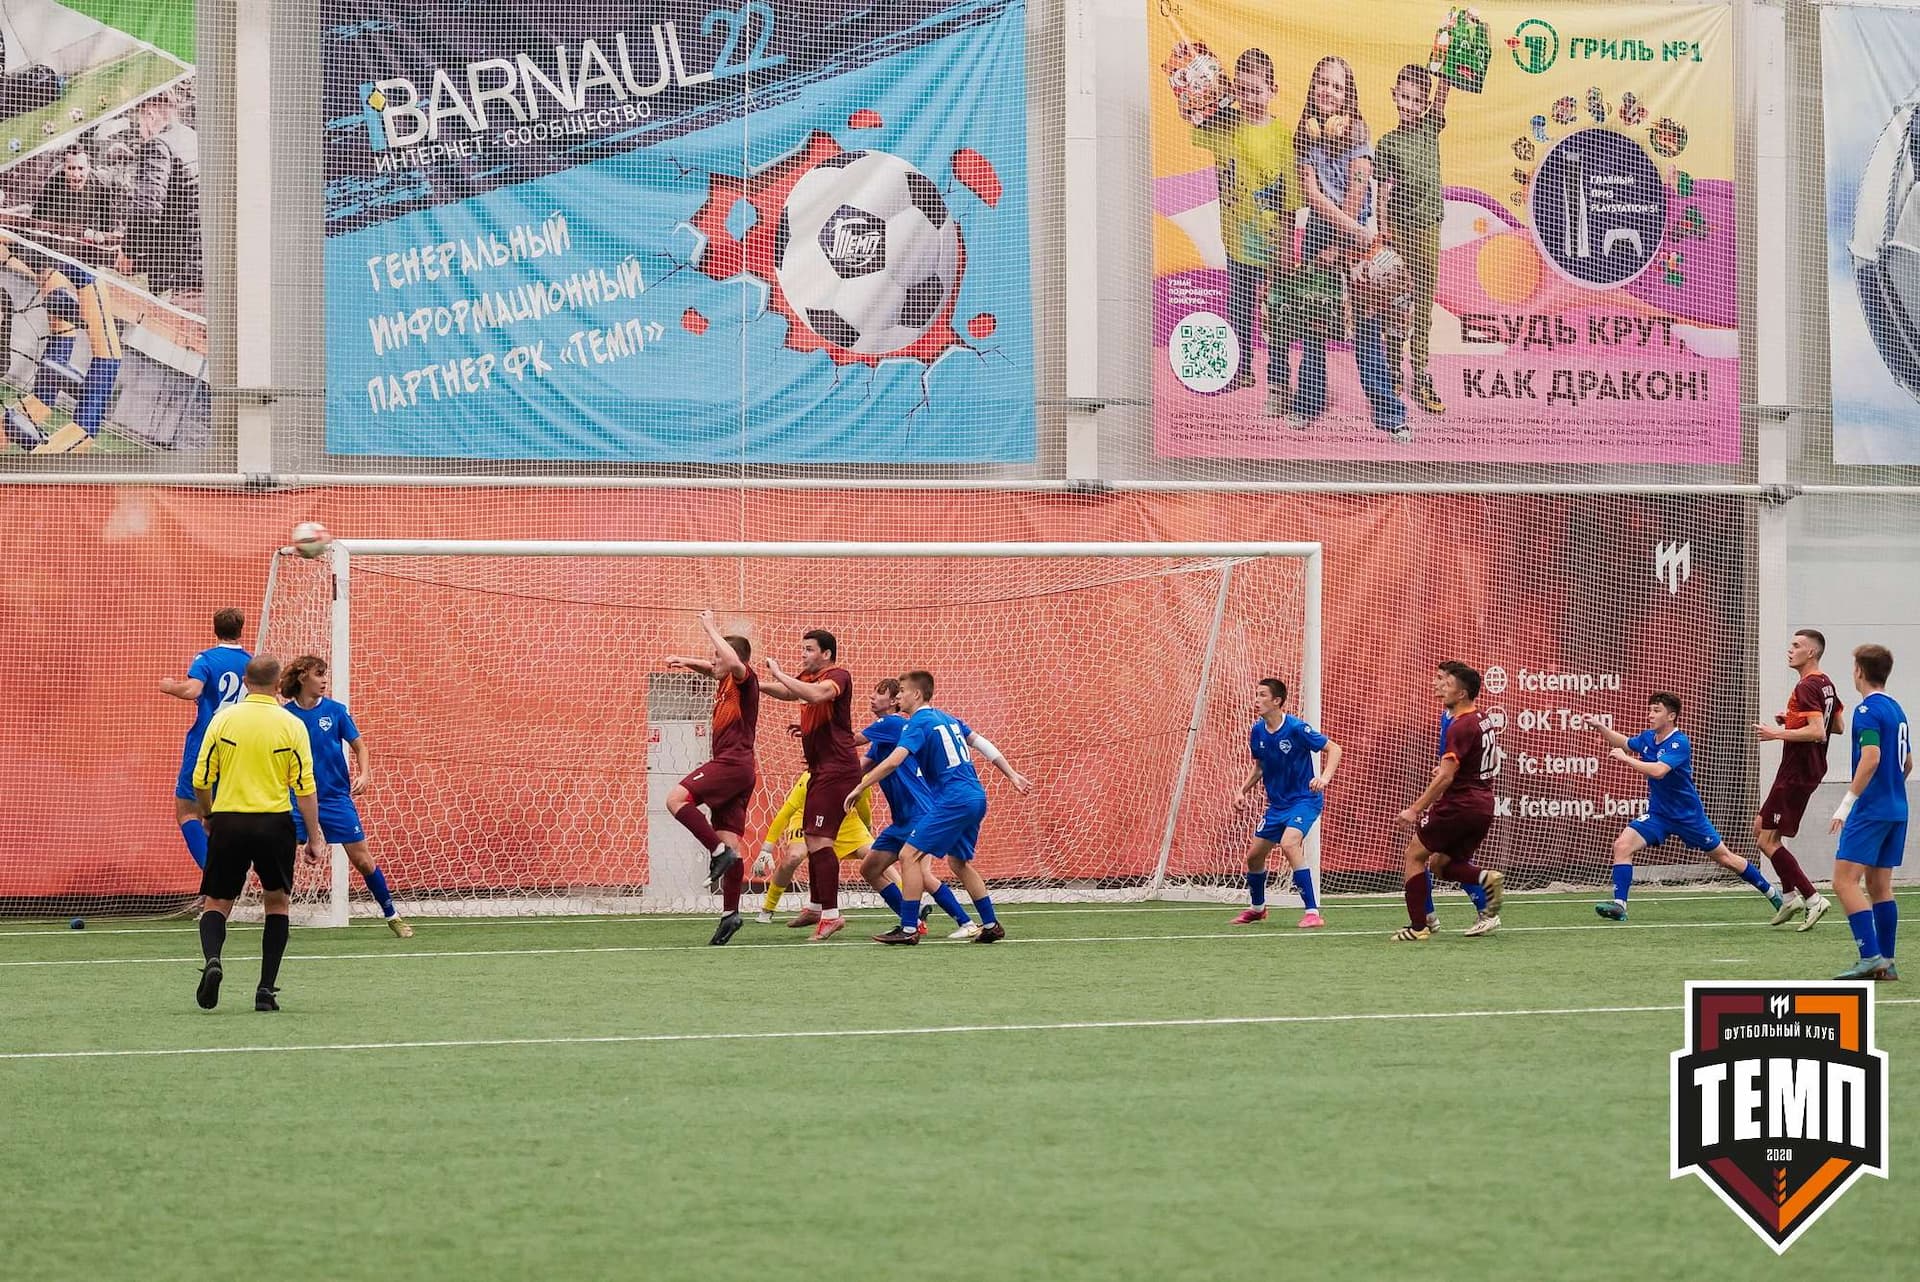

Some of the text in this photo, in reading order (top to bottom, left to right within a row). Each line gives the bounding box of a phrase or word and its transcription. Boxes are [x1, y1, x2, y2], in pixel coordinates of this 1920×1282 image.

[1569, 37, 1703, 62] ГРИЛЬ №1
[374, 136, 484, 173] ИНТЕРНЕТ
[503, 100, 652, 149] СООБЩЕСТВО
[1591, 189, 1614, 198] ПРИЗ
[1591, 204, 1648, 213] PLAYSTATION
[367, 210, 571, 292] ГЕНЕРАЛЬНЫЙ
[368, 254, 646, 356] ИНФОРМАЦИОННЫЙ
[1461, 313, 1685, 354] БУДЬ КРУТ,
[367, 317, 666, 414] ПАРТНЕР ФК «ТЕМП»
[1462, 368, 1709, 407] КАК ДРАКОН!
[1517, 668, 1622, 696] fctemp.ru
[1517, 708, 1552, 731] ФК
[1517, 752, 1600, 779] fc.temp
[815, 815, 825, 827] 13
